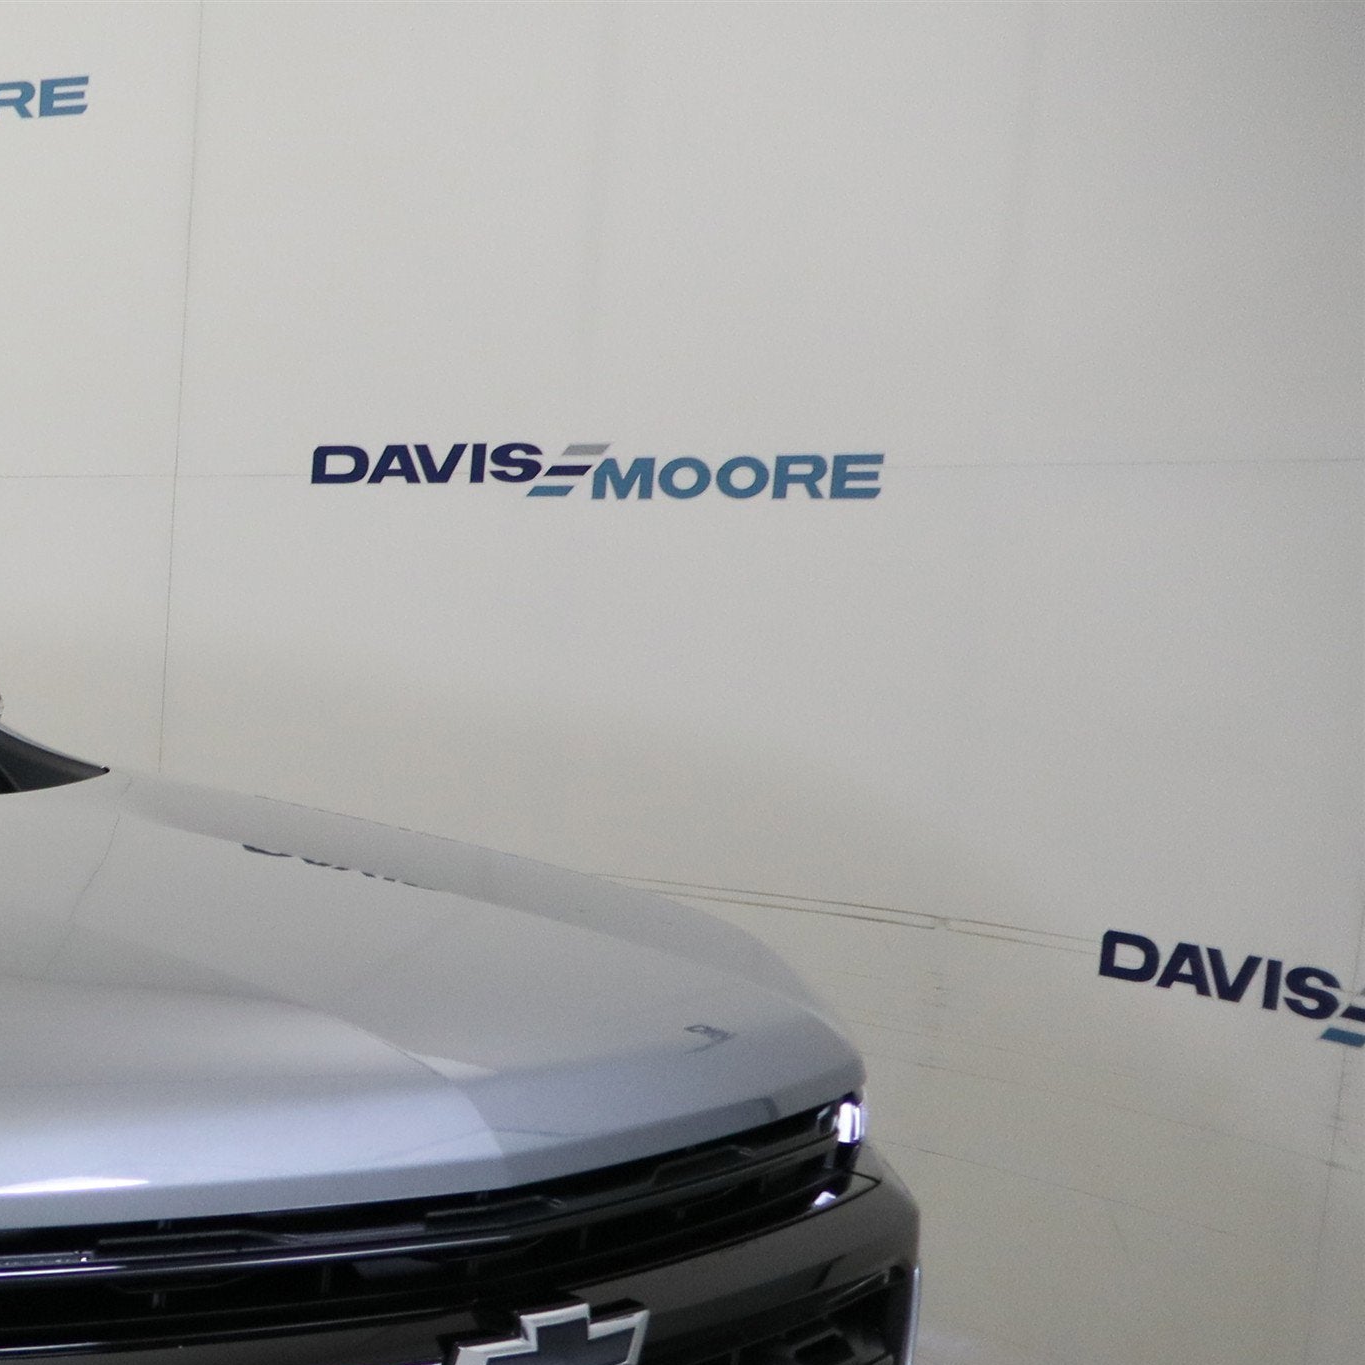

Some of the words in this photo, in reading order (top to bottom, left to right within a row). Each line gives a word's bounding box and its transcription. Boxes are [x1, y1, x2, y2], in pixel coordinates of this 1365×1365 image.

[310, 442, 544, 484] DAVIS
[591, 453, 885, 500] MOORE
[1098, 930, 1342, 1020] DAVIS
